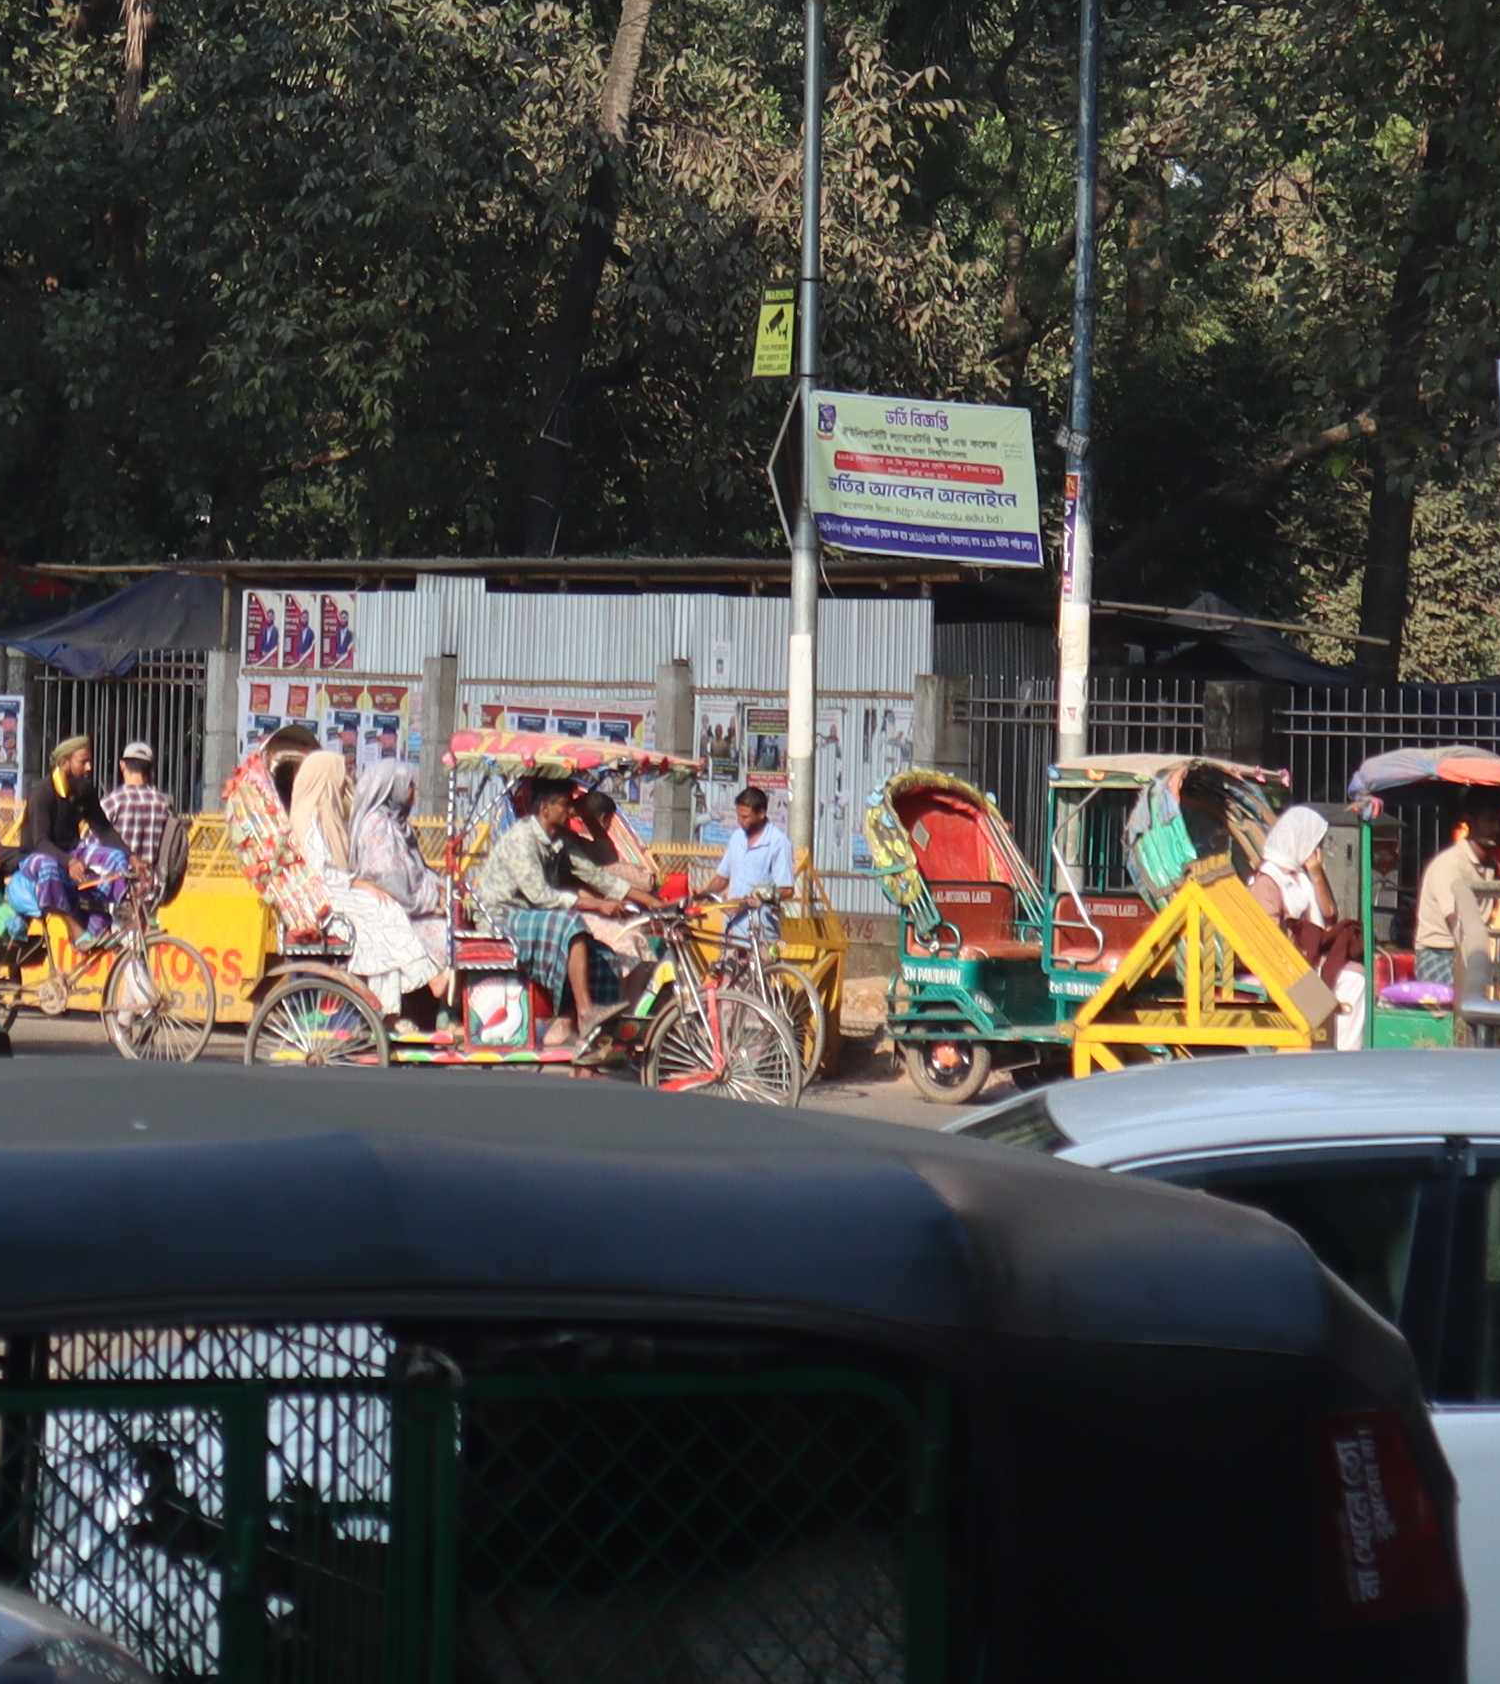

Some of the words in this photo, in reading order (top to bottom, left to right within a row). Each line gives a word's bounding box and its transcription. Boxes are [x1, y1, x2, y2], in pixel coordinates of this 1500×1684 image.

[885, 406, 909, 426] ভর্তি
[910, 408, 950, 432] বিজ্ঞপ্তি
[934, 436, 949, 449] স্কুল
[970, 439, 998, 451] কলেজ
[828, 474, 864, 496] ভর্তির
[869, 482, 934, 503] আবেদন
[938, 488, 1018, 509] অনলাইনে
